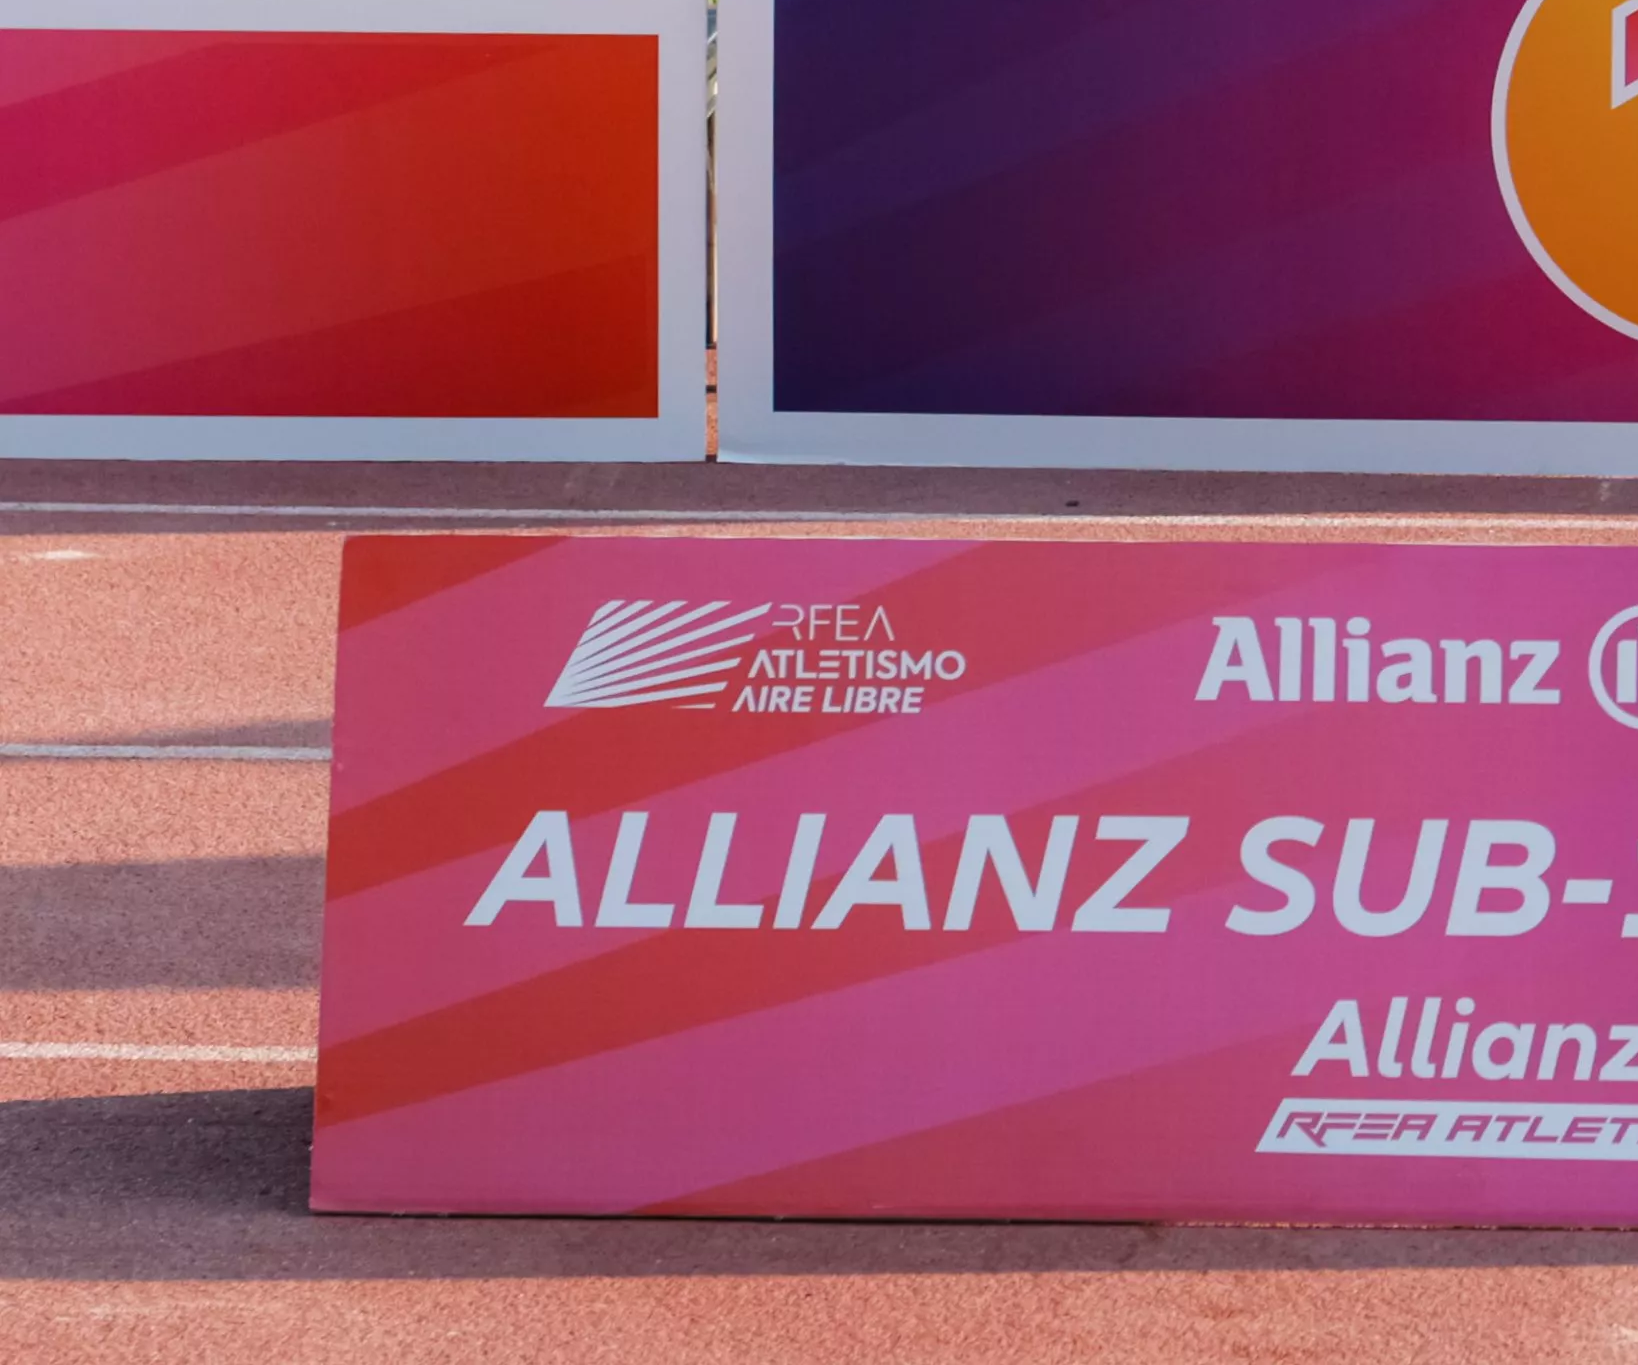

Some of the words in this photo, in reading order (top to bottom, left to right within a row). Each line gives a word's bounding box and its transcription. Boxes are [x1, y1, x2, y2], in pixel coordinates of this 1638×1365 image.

[772, 603, 895, 641] RFEA
[747, 648, 966, 682] ATLETISMO
[1194, 616, 1561, 705] Allianz
[731, 685, 814, 713] AIRE
[822, 685, 925, 714] LIBRE
[463, 810, 1190, 933] ALLIANZ
[1276, 1110, 1437, 1148] RFEA
